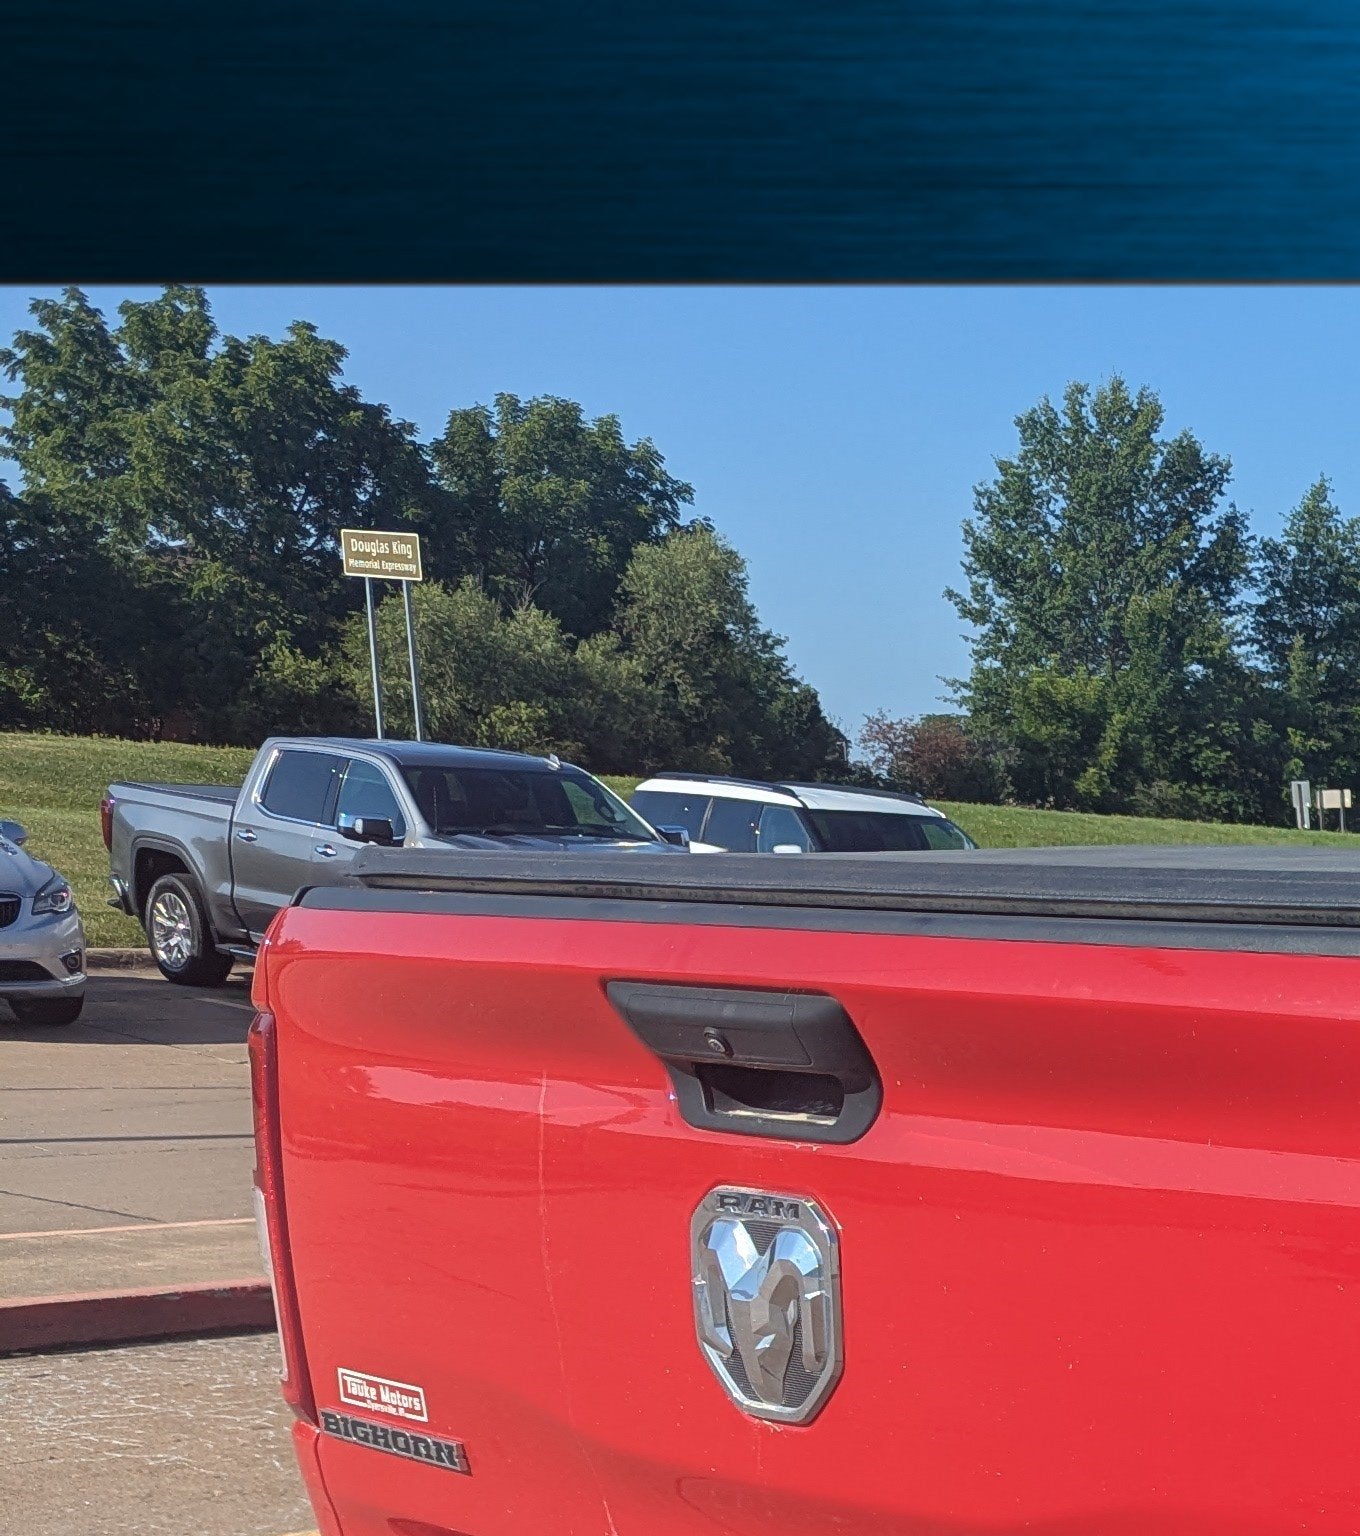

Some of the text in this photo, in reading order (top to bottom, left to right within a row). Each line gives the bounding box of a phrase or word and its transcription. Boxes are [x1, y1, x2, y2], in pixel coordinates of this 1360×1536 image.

[350, 538, 413, 559] Douglas King
[716, 1193, 801, 1220] RAM
[342, 1374, 422, 1411] Tauke Motors
